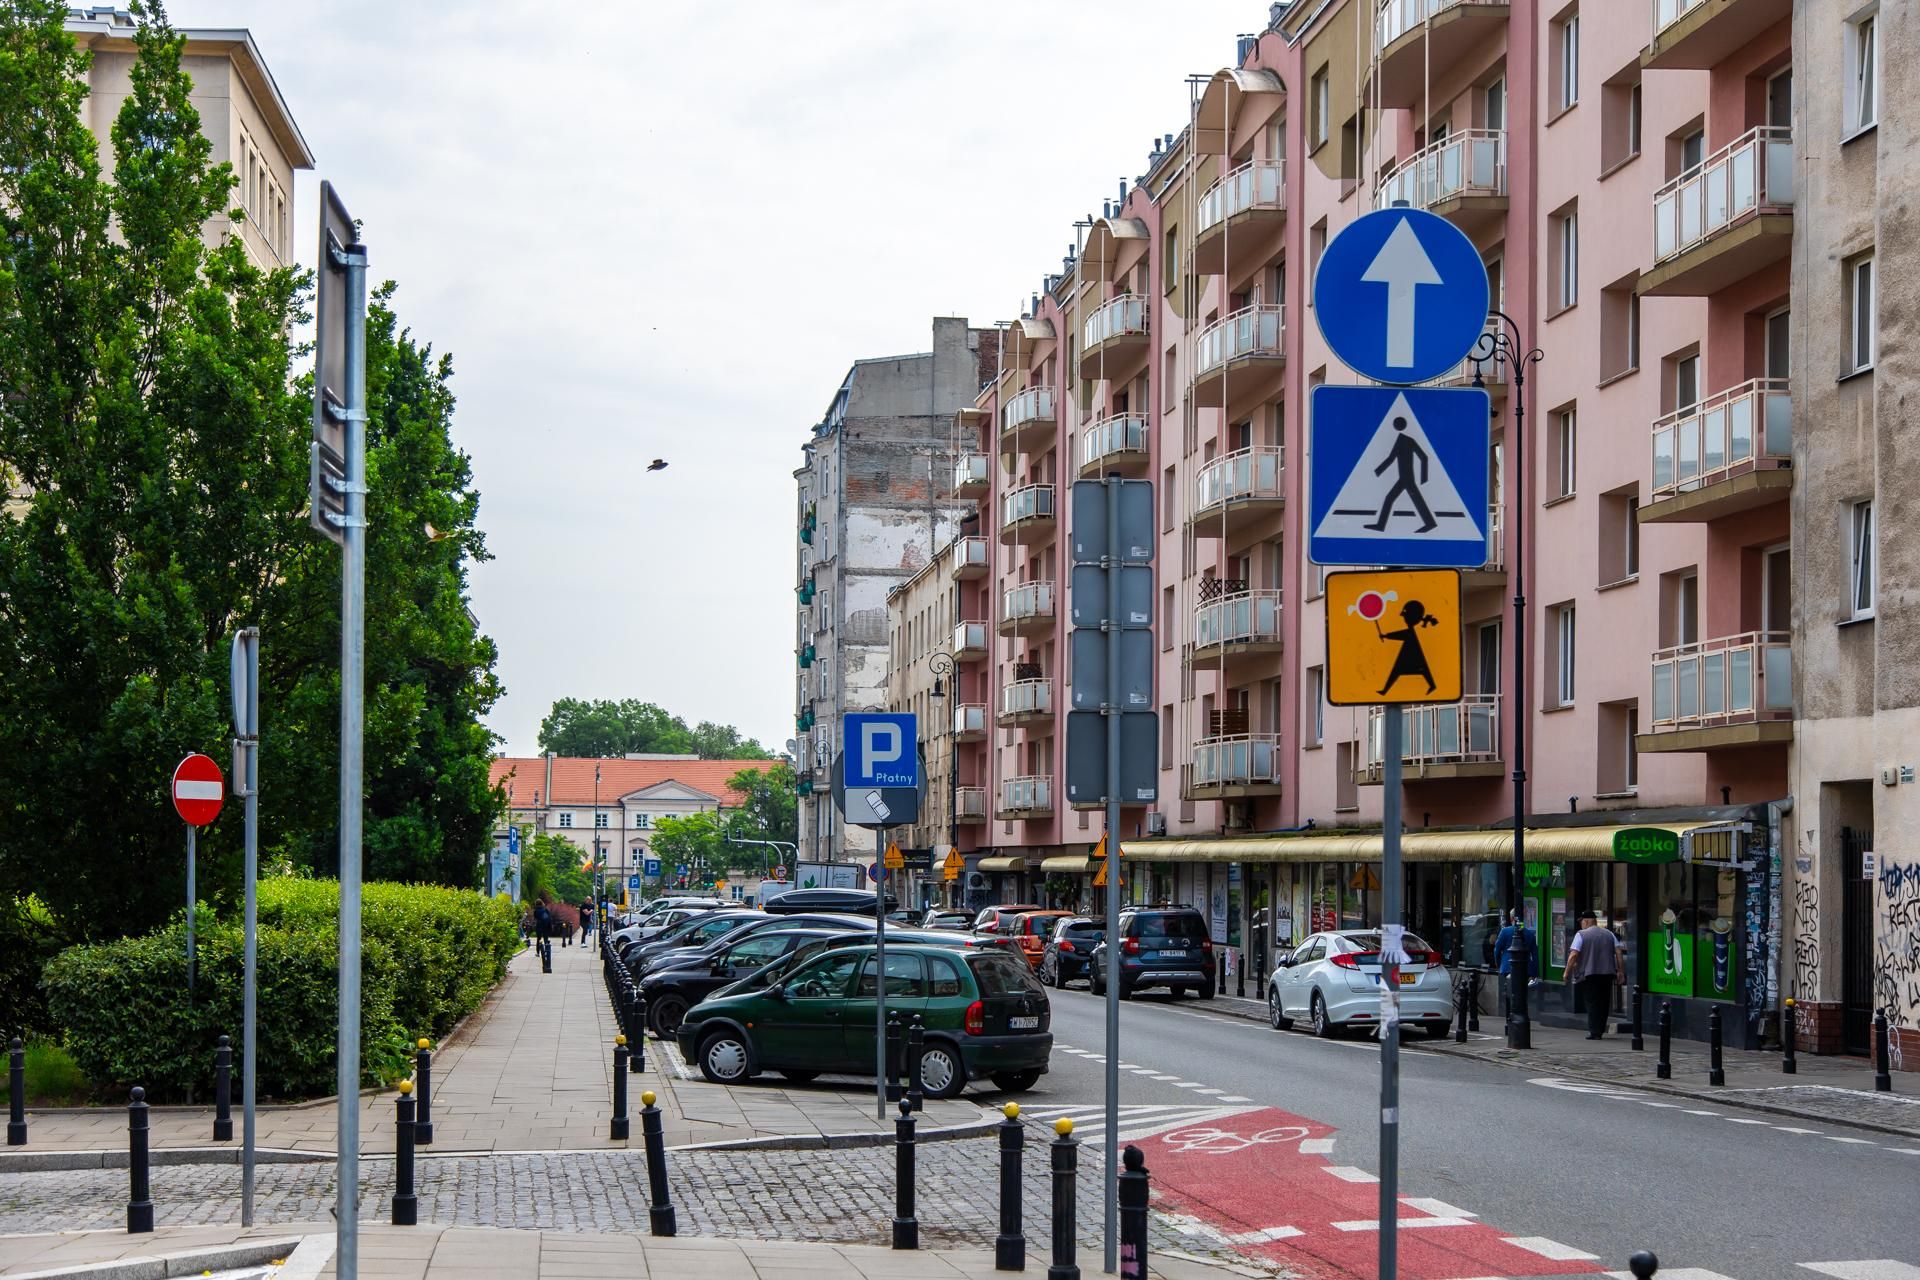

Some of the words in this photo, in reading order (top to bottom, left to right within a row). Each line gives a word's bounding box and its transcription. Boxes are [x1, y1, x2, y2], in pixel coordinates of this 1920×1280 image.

[861, 722, 902, 778] P
[876, 772, 913, 785] Płatny
[511, 828, 517, 845] P
[1619, 835, 1675, 852] żabka
[648, 861, 658, 874] P
[631, 878, 638, 887] P
